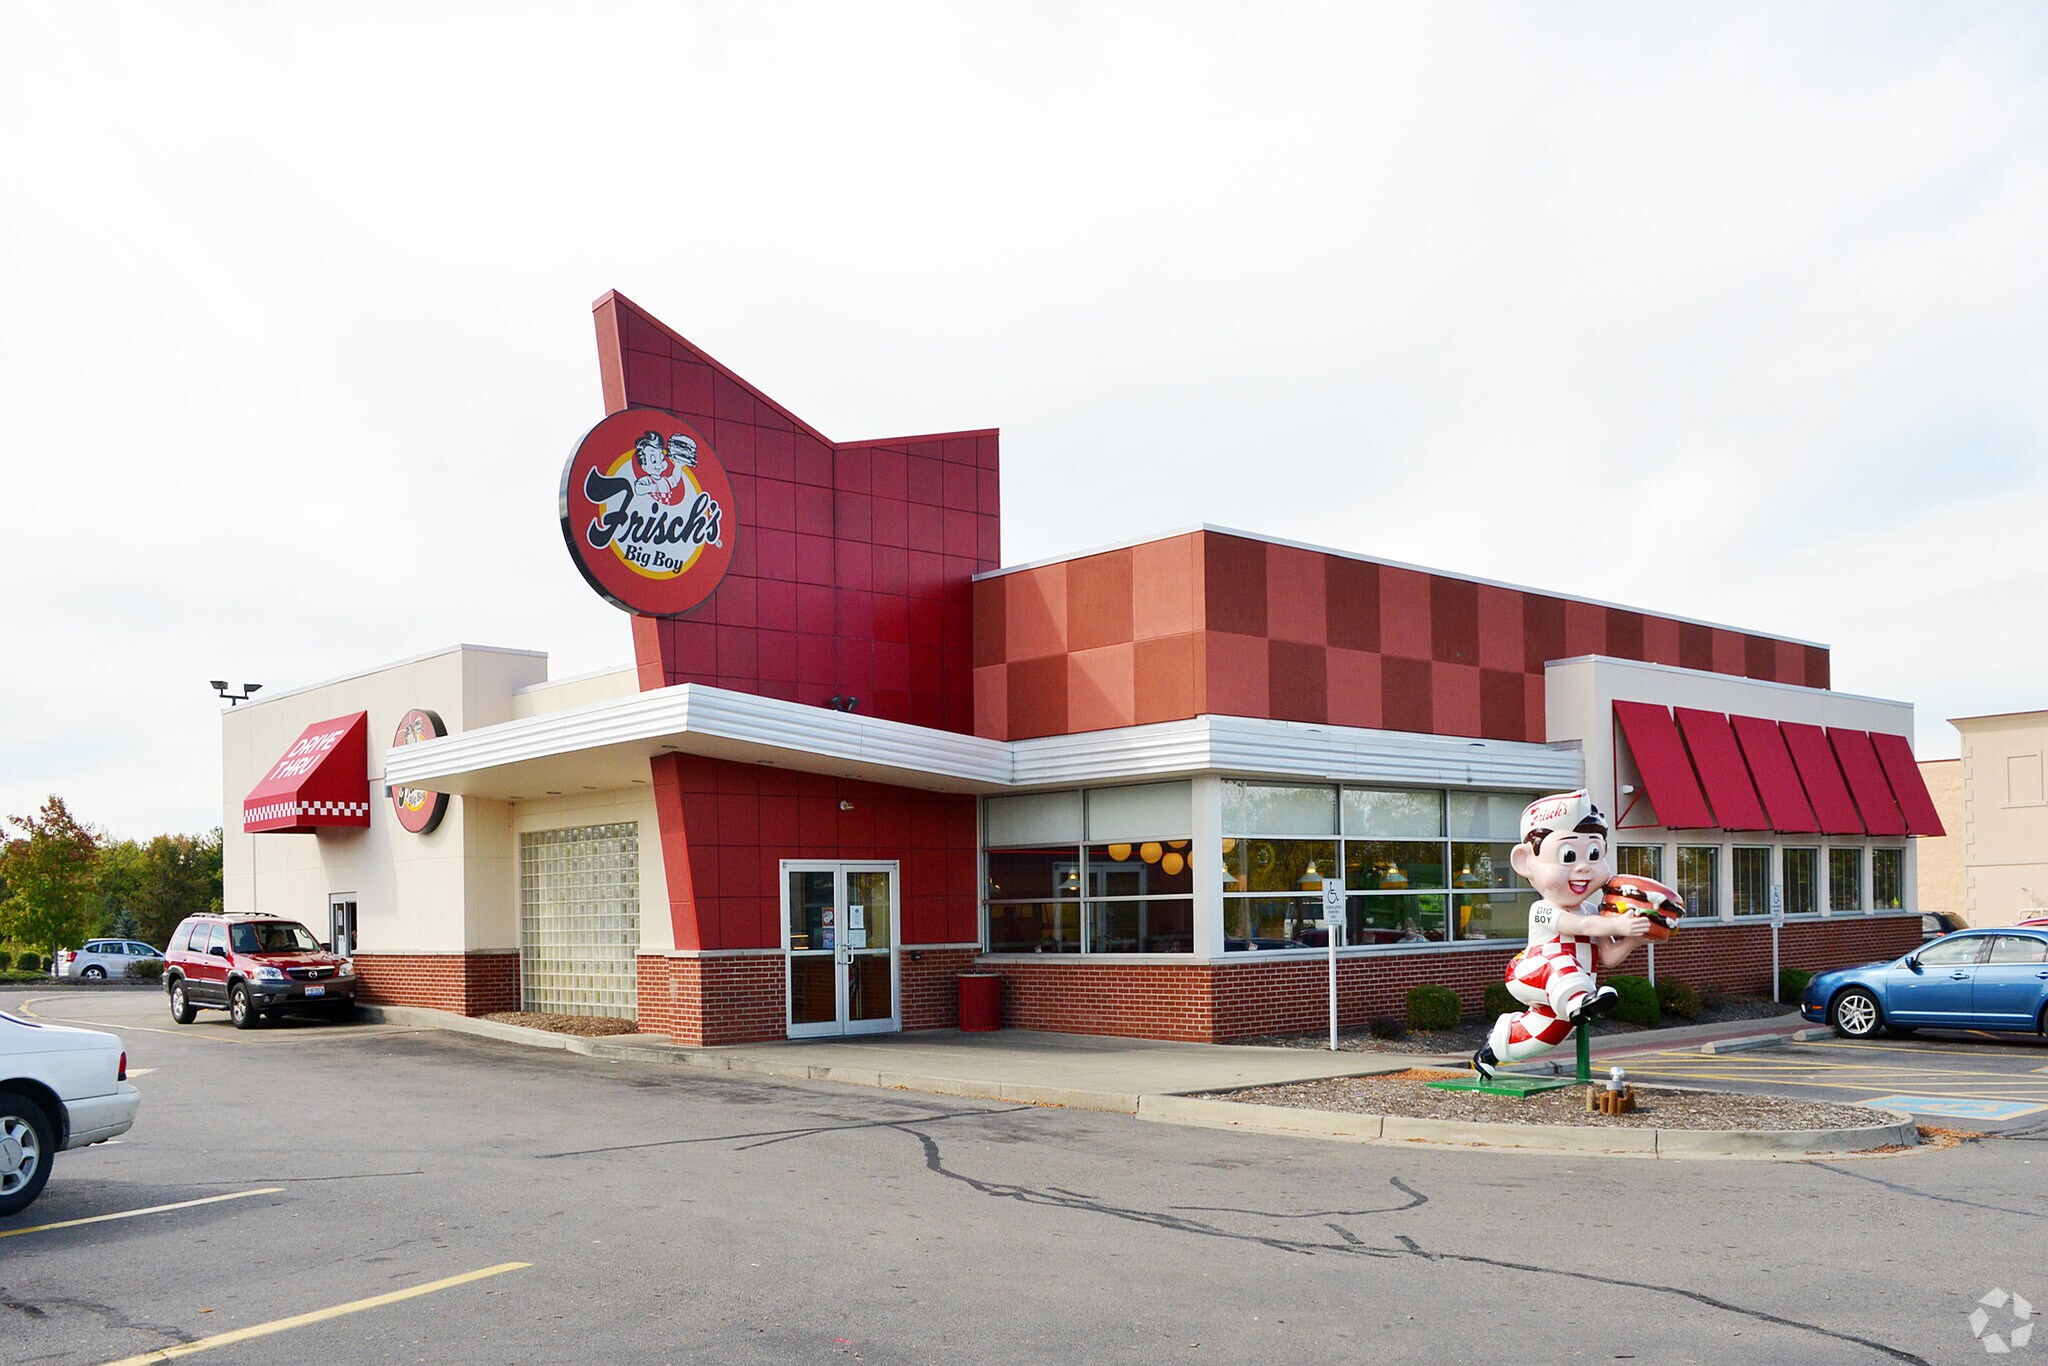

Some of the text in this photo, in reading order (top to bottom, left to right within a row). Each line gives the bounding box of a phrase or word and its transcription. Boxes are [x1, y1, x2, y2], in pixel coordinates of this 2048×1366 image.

[585, 467, 721, 548] Frisch's
[624, 544, 683, 574] Big Boy
[287, 729, 345, 759] DRIVE
[269, 753, 322, 780] THRU
[1530, 801, 1569, 827] Frisch's
[1534, 915, 1552, 924] BOY
[1536, 906, 1553, 915] BIG
